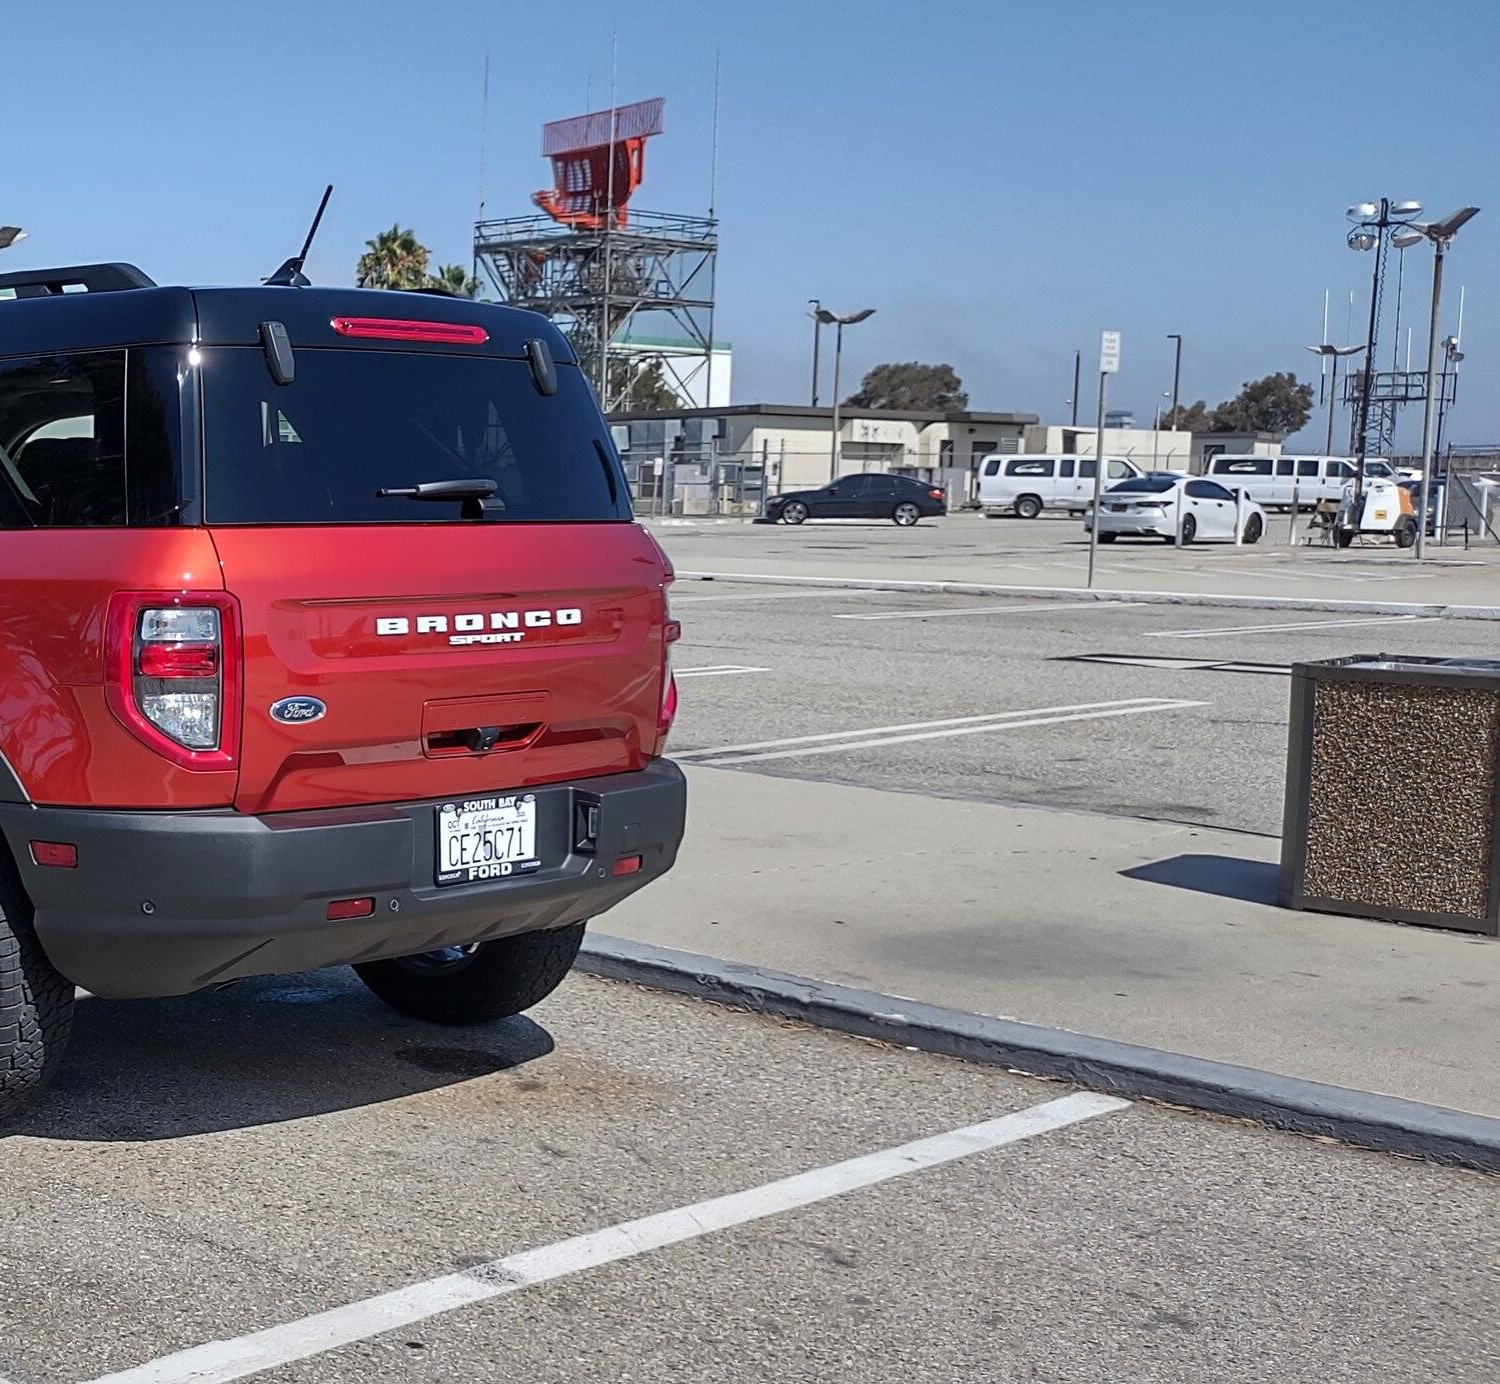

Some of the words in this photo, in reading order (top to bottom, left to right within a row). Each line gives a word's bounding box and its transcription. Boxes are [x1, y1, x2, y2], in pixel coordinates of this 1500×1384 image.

[376, 608, 582, 635] BRONCO
[449, 632, 525, 645] SPORT
[284, 702, 315, 718] Ford
[463, 799, 495, 812] SOUTH
[498, 796, 517, 807] BAY
[449, 826, 525, 866] CE25C71
[468, 862, 513, 880] FORD
